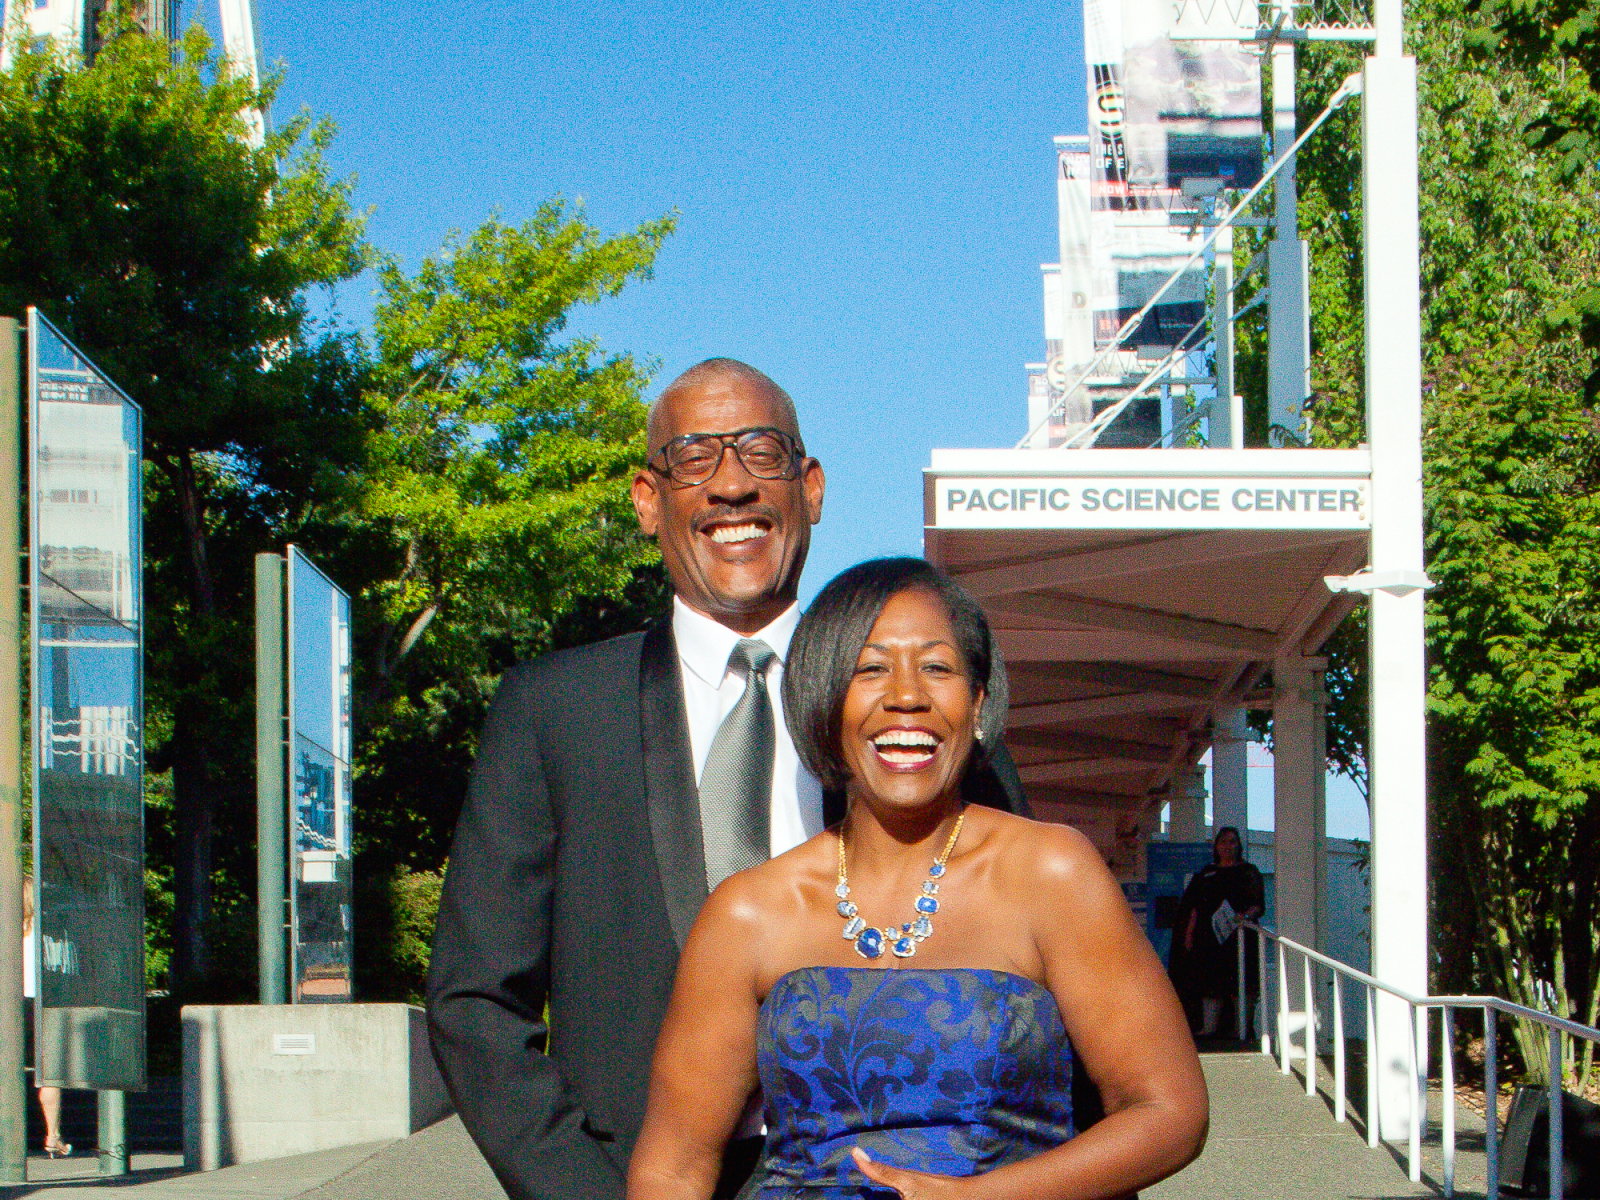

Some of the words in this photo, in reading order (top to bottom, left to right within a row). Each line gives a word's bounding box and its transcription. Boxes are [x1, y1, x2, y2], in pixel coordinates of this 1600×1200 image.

[1095, 158, 1113, 169] OF
[1099, 184, 1125, 195] NOW
[947, 488, 1071, 511] PACIFIC
[1081, 488, 1220, 511] SCIENCE
[1231, 488, 1360, 511] CENTER
